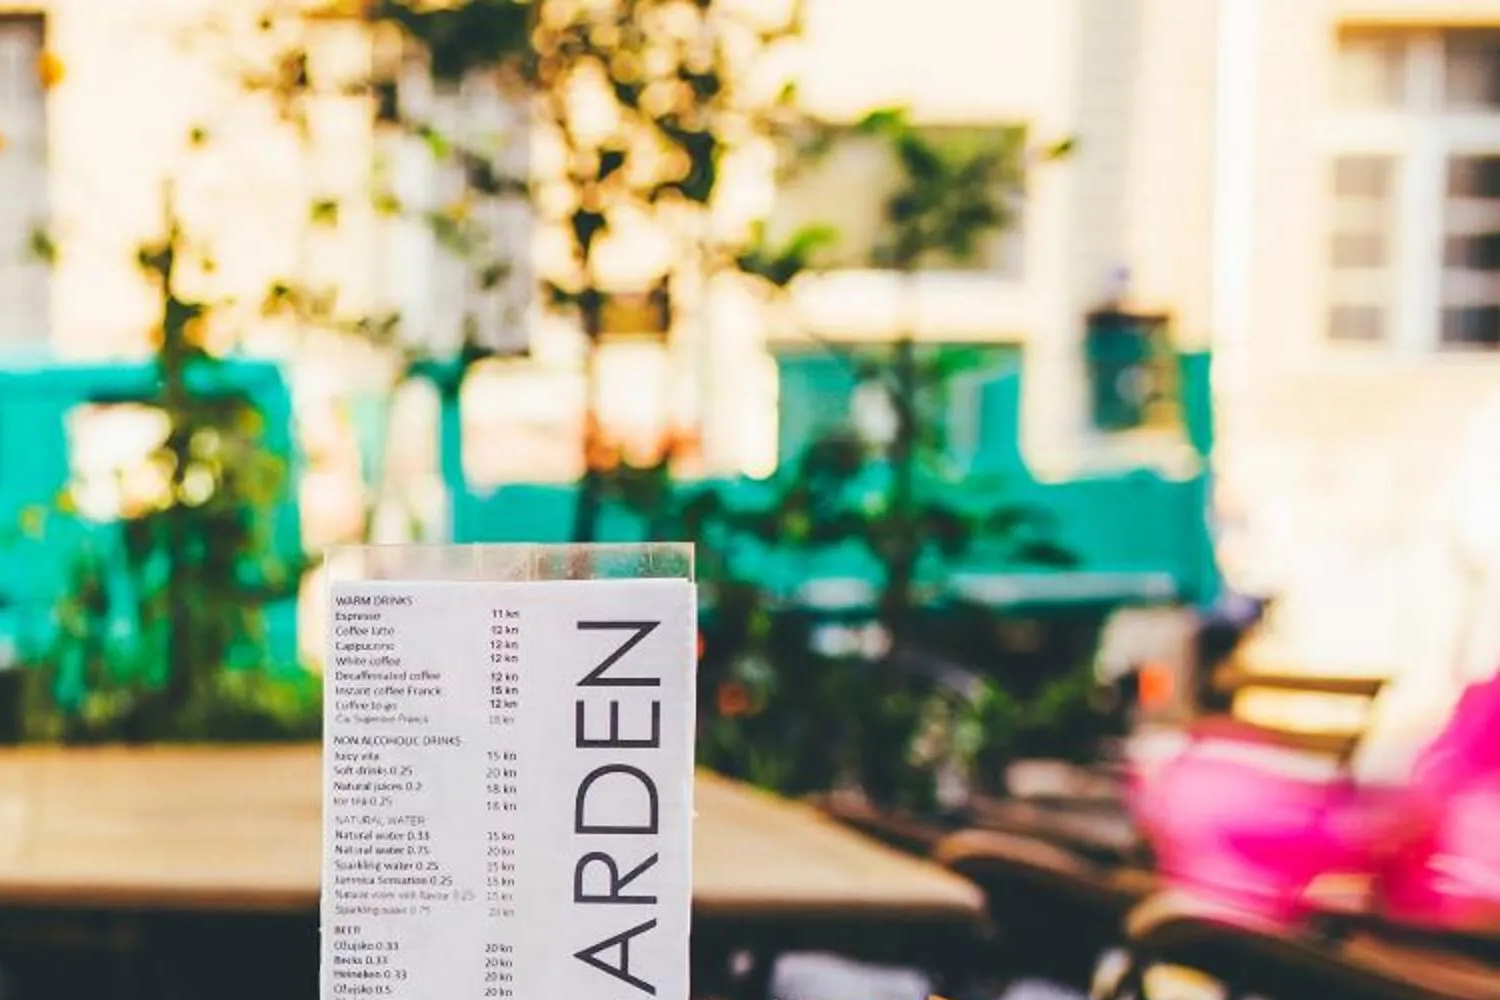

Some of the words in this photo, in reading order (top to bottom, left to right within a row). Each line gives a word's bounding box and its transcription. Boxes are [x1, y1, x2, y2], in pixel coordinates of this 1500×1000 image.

[336, 596, 371, 605] WARM
[374, 596, 413, 606] DRINKS
[336, 613, 380, 622] Espresso
[492, 609, 503, 618] 11
[506, 609, 519, 618] kn
[336, 626, 368, 636] Coffee
[492, 626, 502, 634] 12
[505, 626, 519, 634] kn
[491, 641, 501, 650] 12
[505, 641, 519, 649] kn
[336, 657, 367, 665] White
[370, 656, 400, 666] coffee
[491, 654, 501, 662] 12
[505, 654, 519, 662] kn
[410, 671, 440, 680] coffee
[492, 673, 502, 681] 12
[505, 672, 519, 681] kn
[336, 686, 370, 695] Instant
[374, 686, 404, 695] coffee
[408, 686, 440, 695] Franck
[505, 686, 518, 694] kn
[336, 701, 368, 710] Coffee
[372, 702, 382, 710] to
[490, 700, 501, 709] 12
[504, 700, 517, 709] kn
[503, 716, 514, 724] kn
[334, 736, 358, 745] NON
[362, 736, 420, 746] ALCOHOLIC
[423, 736, 461, 746] DRINKS
[487, 752, 500, 760] 15
[503, 752, 516, 760] kn
[334, 766, 352, 775] Soft
[355, 766, 386, 775] drinks
[486, 768, 500, 778] 20
[503, 768, 516, 777] kn
[334, 782, 369, 790] Natural
[406, 783, 422, 791] 0.2
[503, 784, 516, 793] kn
[351, 798, 367, 806] tea
[503, 801, 516, 810] kn
[335, 831, 372, 840] Natural
[376, 832, 404, 840] water
[502, 832, 514, 840] kn
[335, 846, 372, 855] Natural
[408, 846, 429, 855] 0.75
[487, 847, 500, 856] 20
[501, 847, 514, 856] kn
[384, 862, 413, 870] water
[416, 862, 438, 870] 0.25
[501, 862, 514, 871] kn
[430, 876, 452, 886] 0.25
[501, 877, 514, 886] kn
[501, 892, 512, 901] kn
[485, 944, 497, 953] 20
[500, 944, 513, 953] kn
[485, 959, 497, 968] 20
[500, 958, 513, 967] kn
[334, 970, 382, 979] Heineken
[384, 970, 406, 980] 0.33
[485, 972, 497, 982] 20
[500, 972, 512, 982] kn
[376, 985, 391, 994] 0.5
[484, 988, 497, 997] 20
[500, 987, 513, 996] kn
